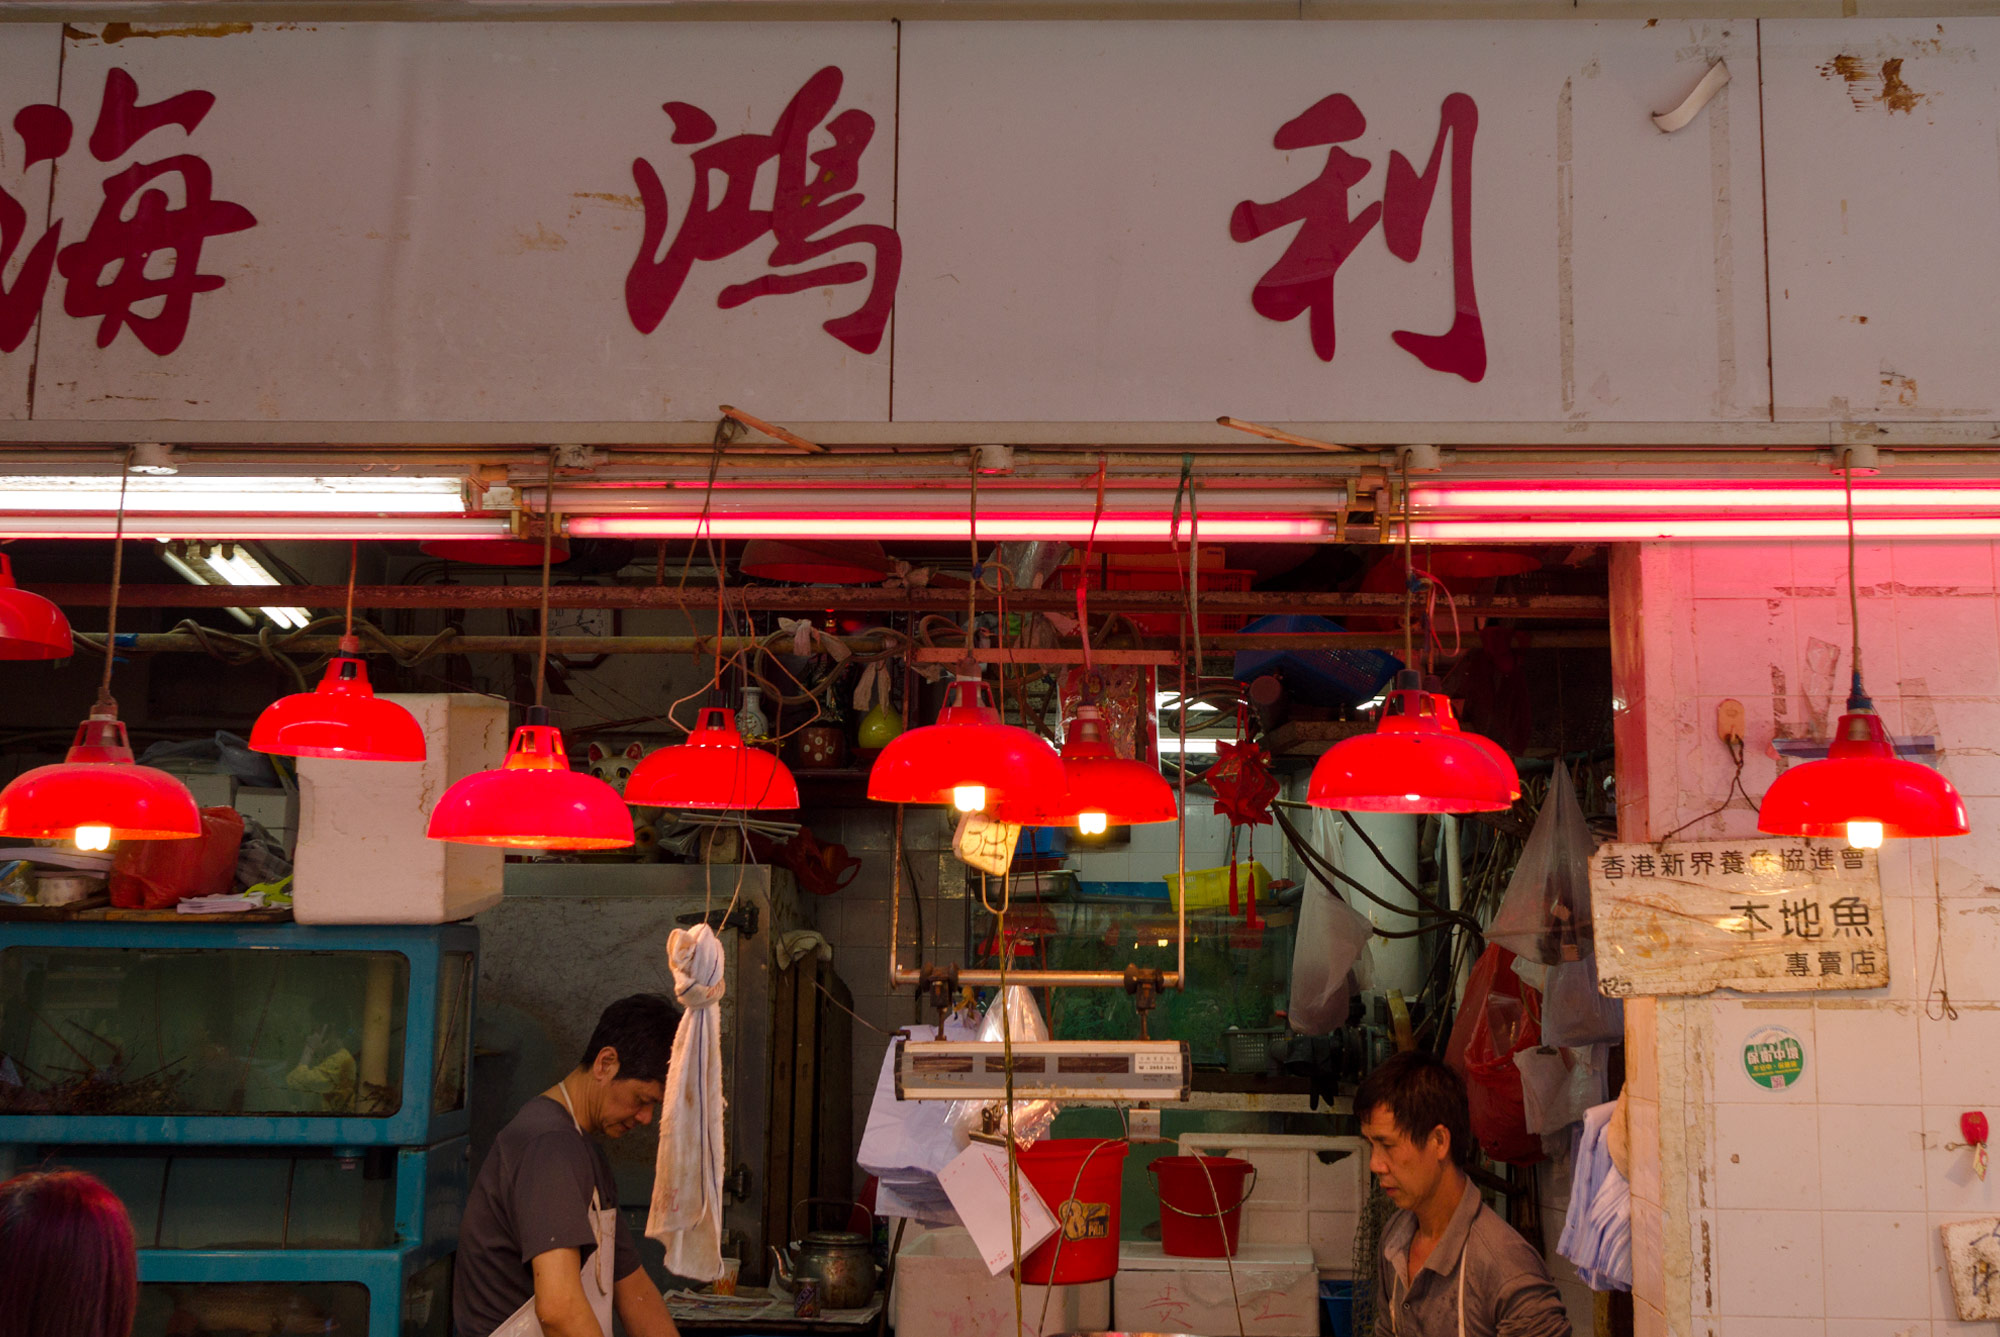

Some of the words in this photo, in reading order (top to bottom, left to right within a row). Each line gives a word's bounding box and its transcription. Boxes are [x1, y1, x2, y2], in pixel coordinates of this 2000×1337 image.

[1229, 92, 1487, 383] 利
[1730, 896, 1873, 940] 本地魚
[1785, 950, 1876, 977] 專賣店
